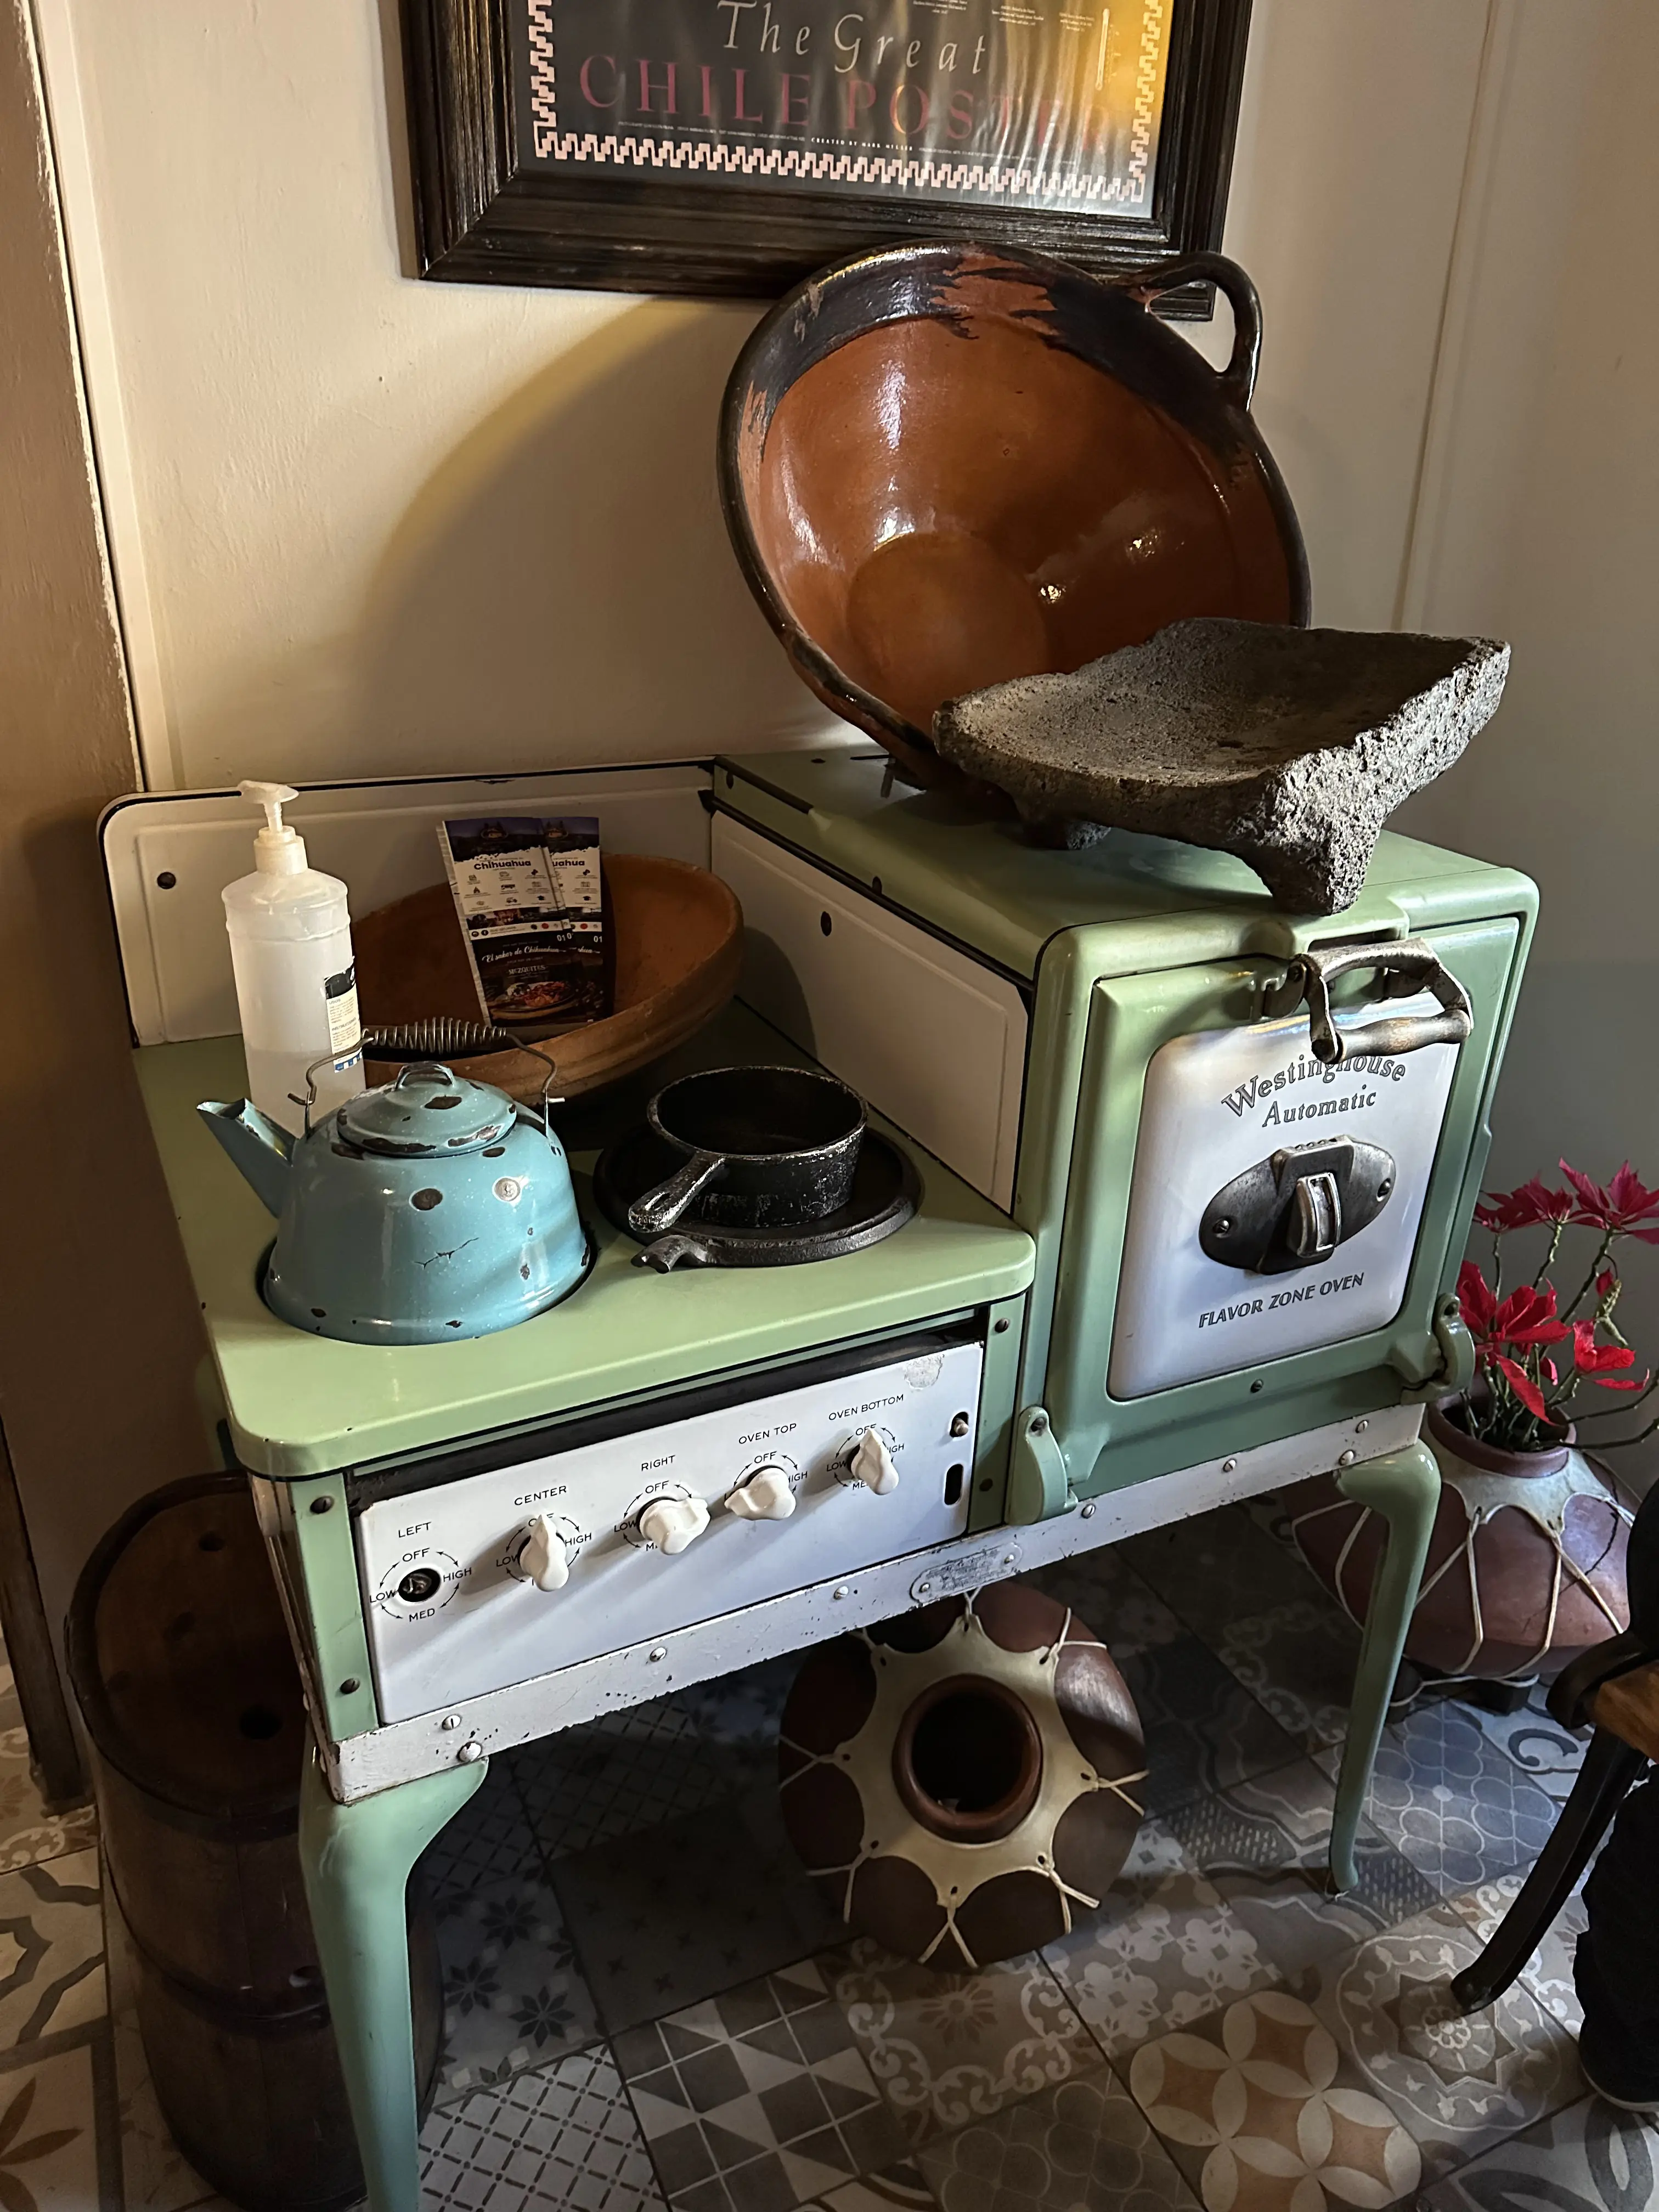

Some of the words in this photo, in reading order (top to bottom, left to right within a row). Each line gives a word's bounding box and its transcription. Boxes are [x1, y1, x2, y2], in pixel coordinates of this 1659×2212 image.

[716, 0, 811, 55] The
[833, 13, 986, 74] Great
[579, 55, 811, 127] CHILE
[473, 860, 532, 870] Chihuahua
[482, 954, 494, 963] El
[495, 951, 513, 961] sabor
[514, 947, 522, 956] de
[1262, 1084, 1376, 1127] Automatic
[1199, 1299, 1263, 1328] FLAVOR
[1268, 1285, 1316, 1310] ZONE
[1319, 1272, 1364, 1295] OVEN
[828, 1407, 857, 1420] OVEN
[861, 1394, 904, 1412] BOTTOM
[738, 1430, 770, 1444] OVEN
[774, 1423, 797, 1435] TOP
[887, 1444, 905, 1454] IGH
[641, 1455, 675, 1471] RIGHT
[754, 1451, 777, 1464] OFF
[826, 1460, 847, 1472] LOW
[645, 1480, 669, 1494] OFF
[853, 1481, 867, 1491] ME
[514, 1485, 567, 1505] CENTER
[528, 1513, 554, 1527] OF
[614, 1520, 637, 1532] LOW
[398, 1521, 432, 1538] LEFT
[565, 1532, 592, 1547] HIGH
[402, 1547, 430, 1562] OFF
[443, 1567, 472, 1583] HIGH
[369, 1588, 396, 1604] LOW
[409, 1608, 435, 1622] MED
